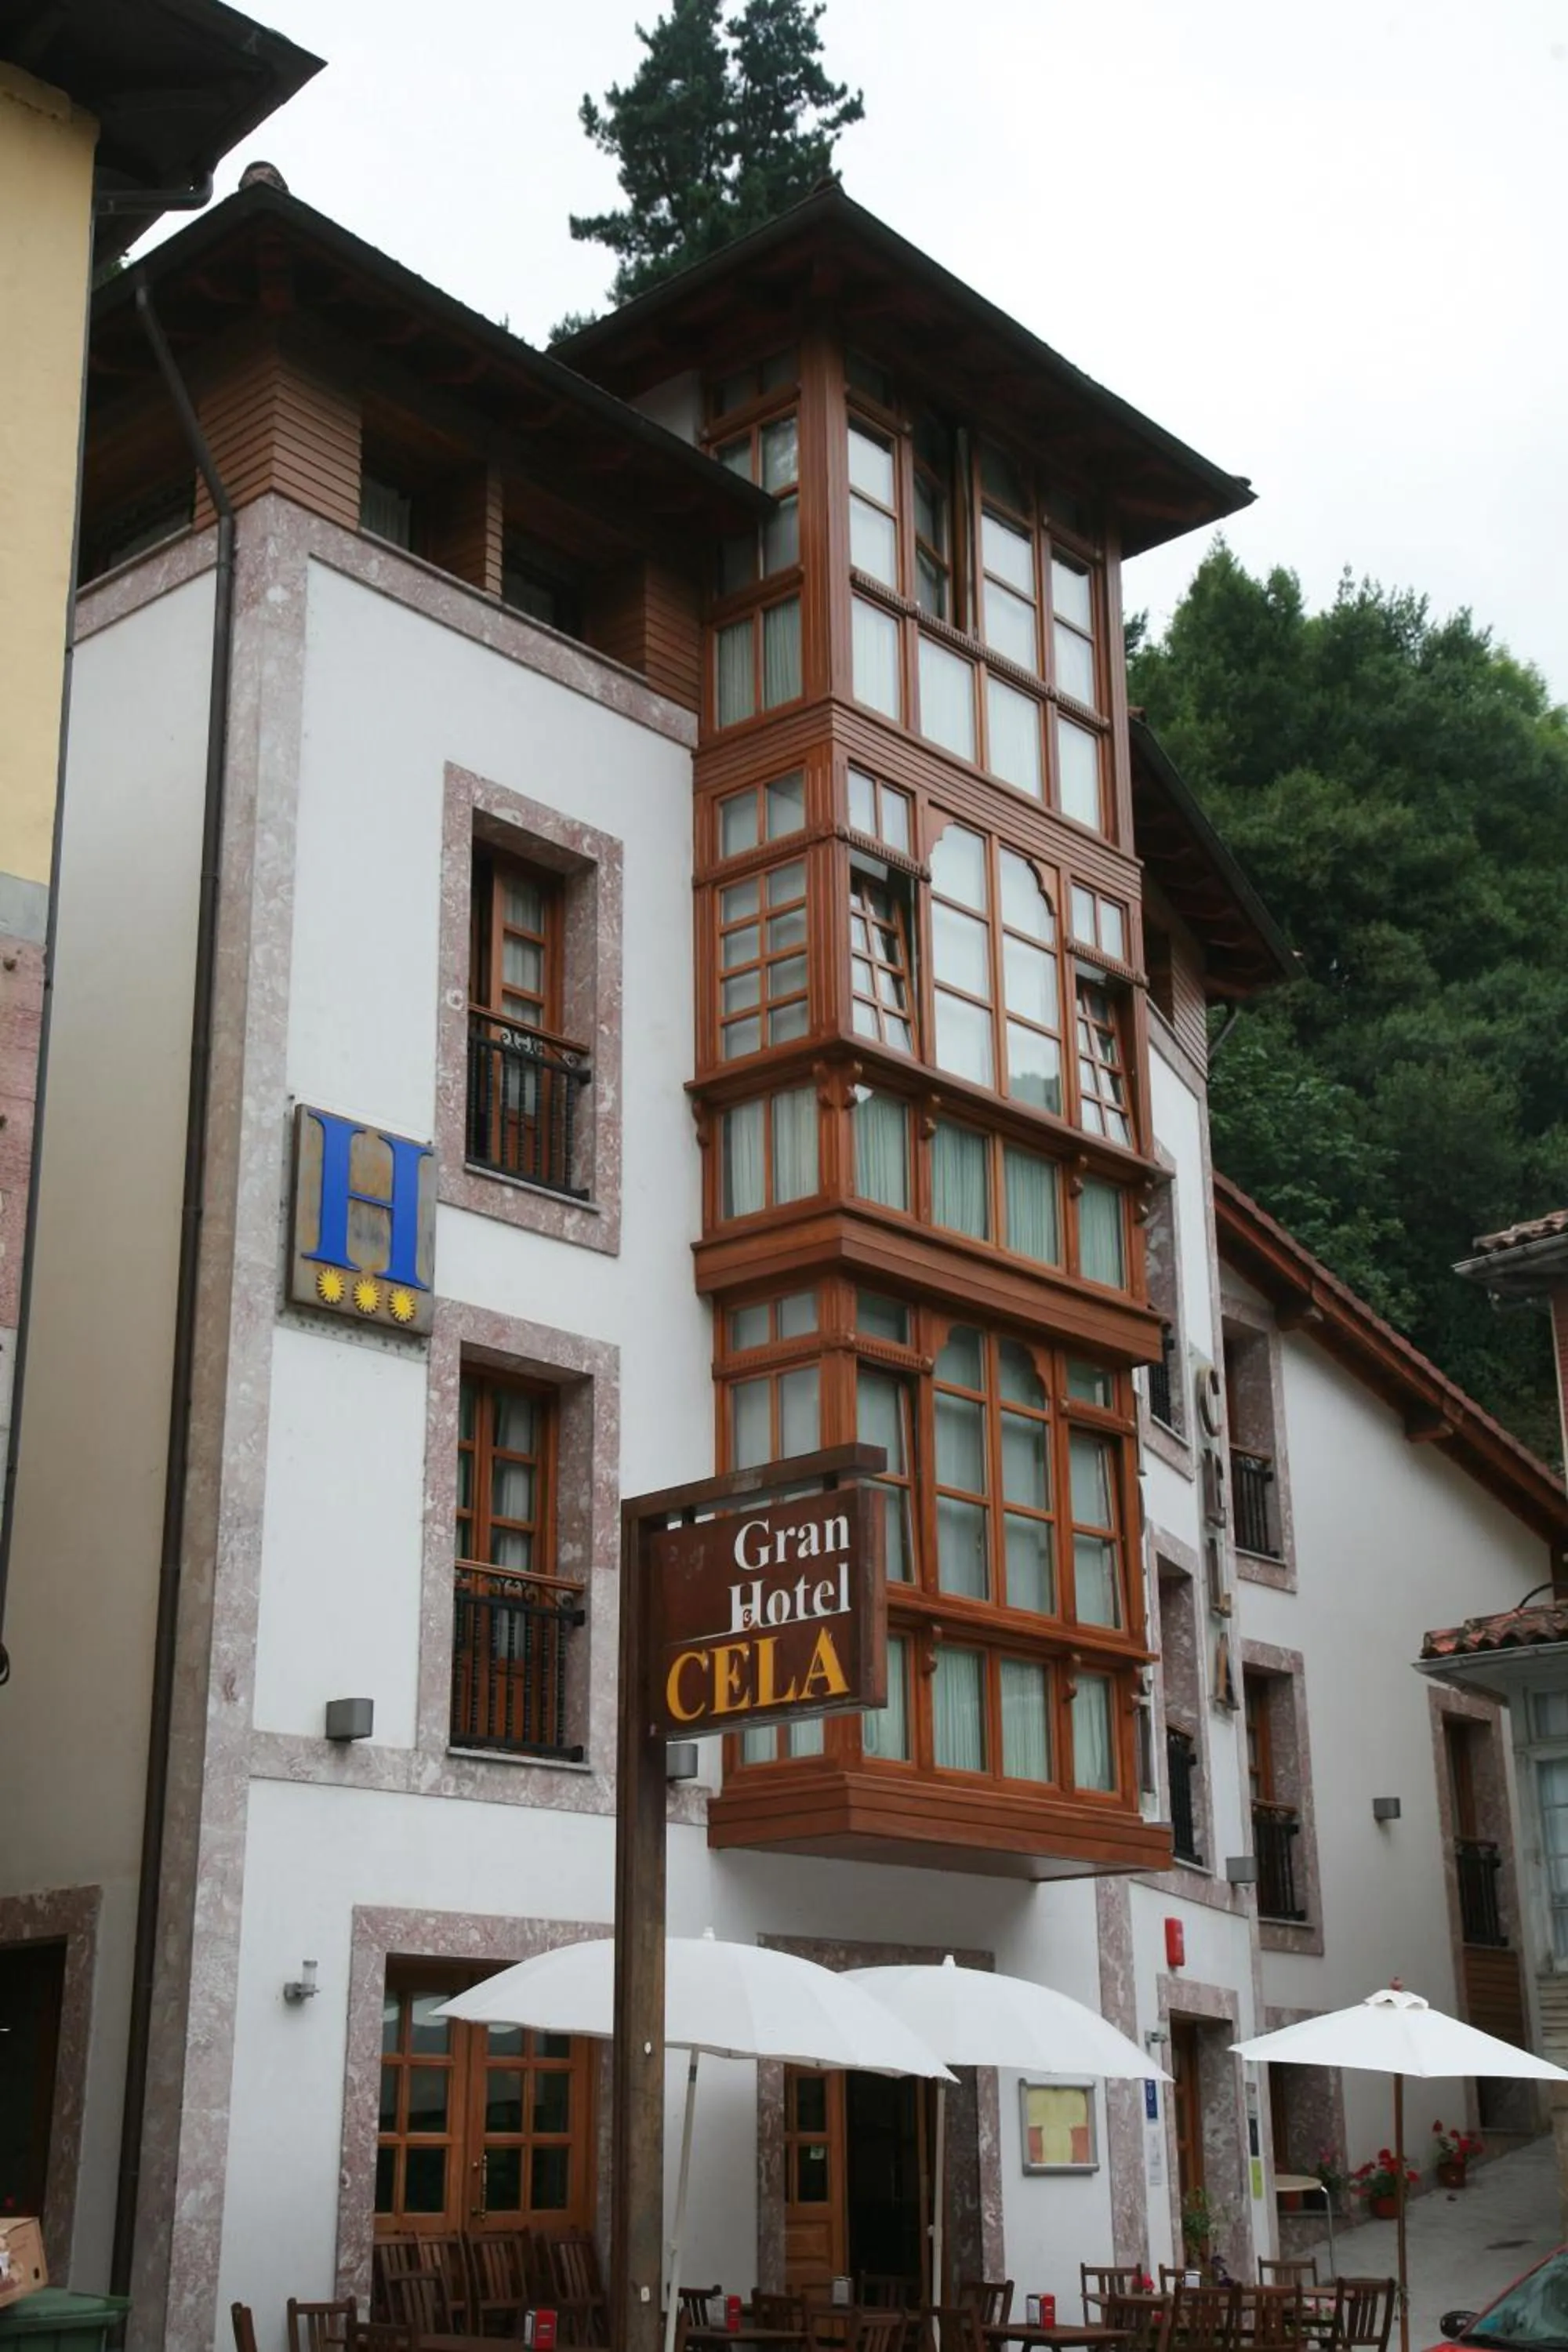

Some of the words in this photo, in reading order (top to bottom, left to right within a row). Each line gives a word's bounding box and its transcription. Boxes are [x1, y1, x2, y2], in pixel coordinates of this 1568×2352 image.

[301, 1108, 434, 1292] H
[734, 1514, 851, 1570] Gran
[728, 1563, 851, 1634] Hotel
[666, 1627, 851, 1721] CELA
